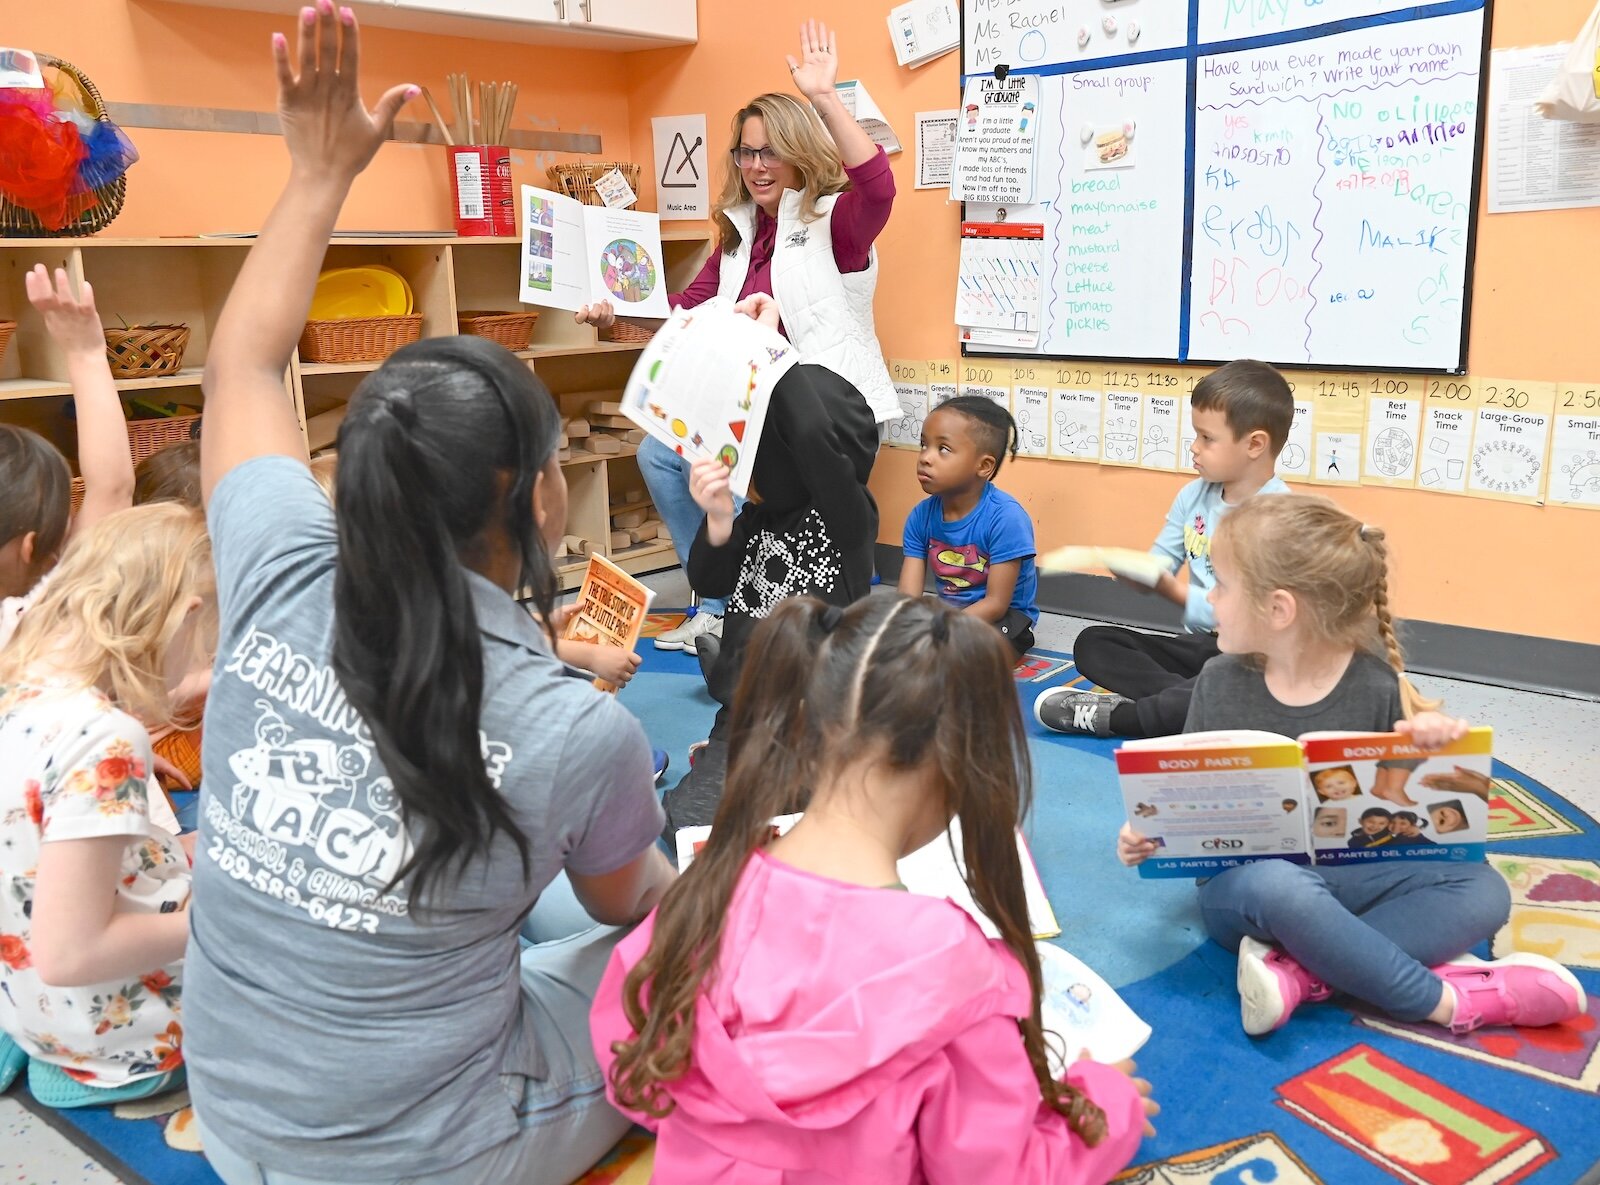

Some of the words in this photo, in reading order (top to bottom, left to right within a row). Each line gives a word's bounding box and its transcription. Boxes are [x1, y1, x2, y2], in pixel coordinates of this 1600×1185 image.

[1008, 6, 1065, 30] Rachel
[1204, 58, 1241, 79] Have
[1251, 58, 1280, 80] you
[1288, 54, 1325, 68] ever
[1338, 45, 1382, 65] made
[1390, 46, 1424, 67] your
[1370, 64, 1402, 85] your
[1073, 74, 1112, 91] Small
[1333, 102, 1362, 119] NO
[1071, 174, 1120, 193] bread
[1071, 199, 1158, 219] mayonnaise
[1072, 221, 1111, 236] meat
[1068, 240, 1120, 256] mustard
[1066, 317, 1110, 337] pickles
[1104, 372, 1140, 387] 11:25
[1147, 372, 1178, 387] 11:30
[1371, 378, 1408, 394] 1:00
[914, 388, 928, 396] Time
[1020, 388, 1048, 398] Planning
[1319, 381, 1360, 398] 12:45
[1430, 381, 1471, 400] 2:00
[1025, 397, 1041, 405] Time
[1079, 394, 1095, 402] Time
[1108, 394, 1139, 403] Cleanup
[1151, 398, 1174, 406] Recall
[1486, 387, 1529, 408] 2:30
[1153, 407, 1170, 415] Time
[1388, 401, 1407, 410] Rest
[1386, 411, 1407, 420] Time
[1433, 411, 1463, 420] Snack
[1480, 411, 1544, 426] Large-Group
[1436, 421, 1458, 430] Time
[1500, 423, 1522, 433] Time
[1328, 436, 1342, 444] Yoga
[597, 609, 616, 631] LITTLE
[1343, 745, 1385, 758] BODY
[1158, 758, 1200, 770] BODY
[1204, 756, 1253, 768] PARTS
[1338, 851, 1378, 859] PARTES
[1406, 848, 1448, 856] CUERPO
[1157, 861, 1177, 870] LAS
[1180, 860, 1218, 868] PARTES
[1221, 859, 1240, 867] DEL
